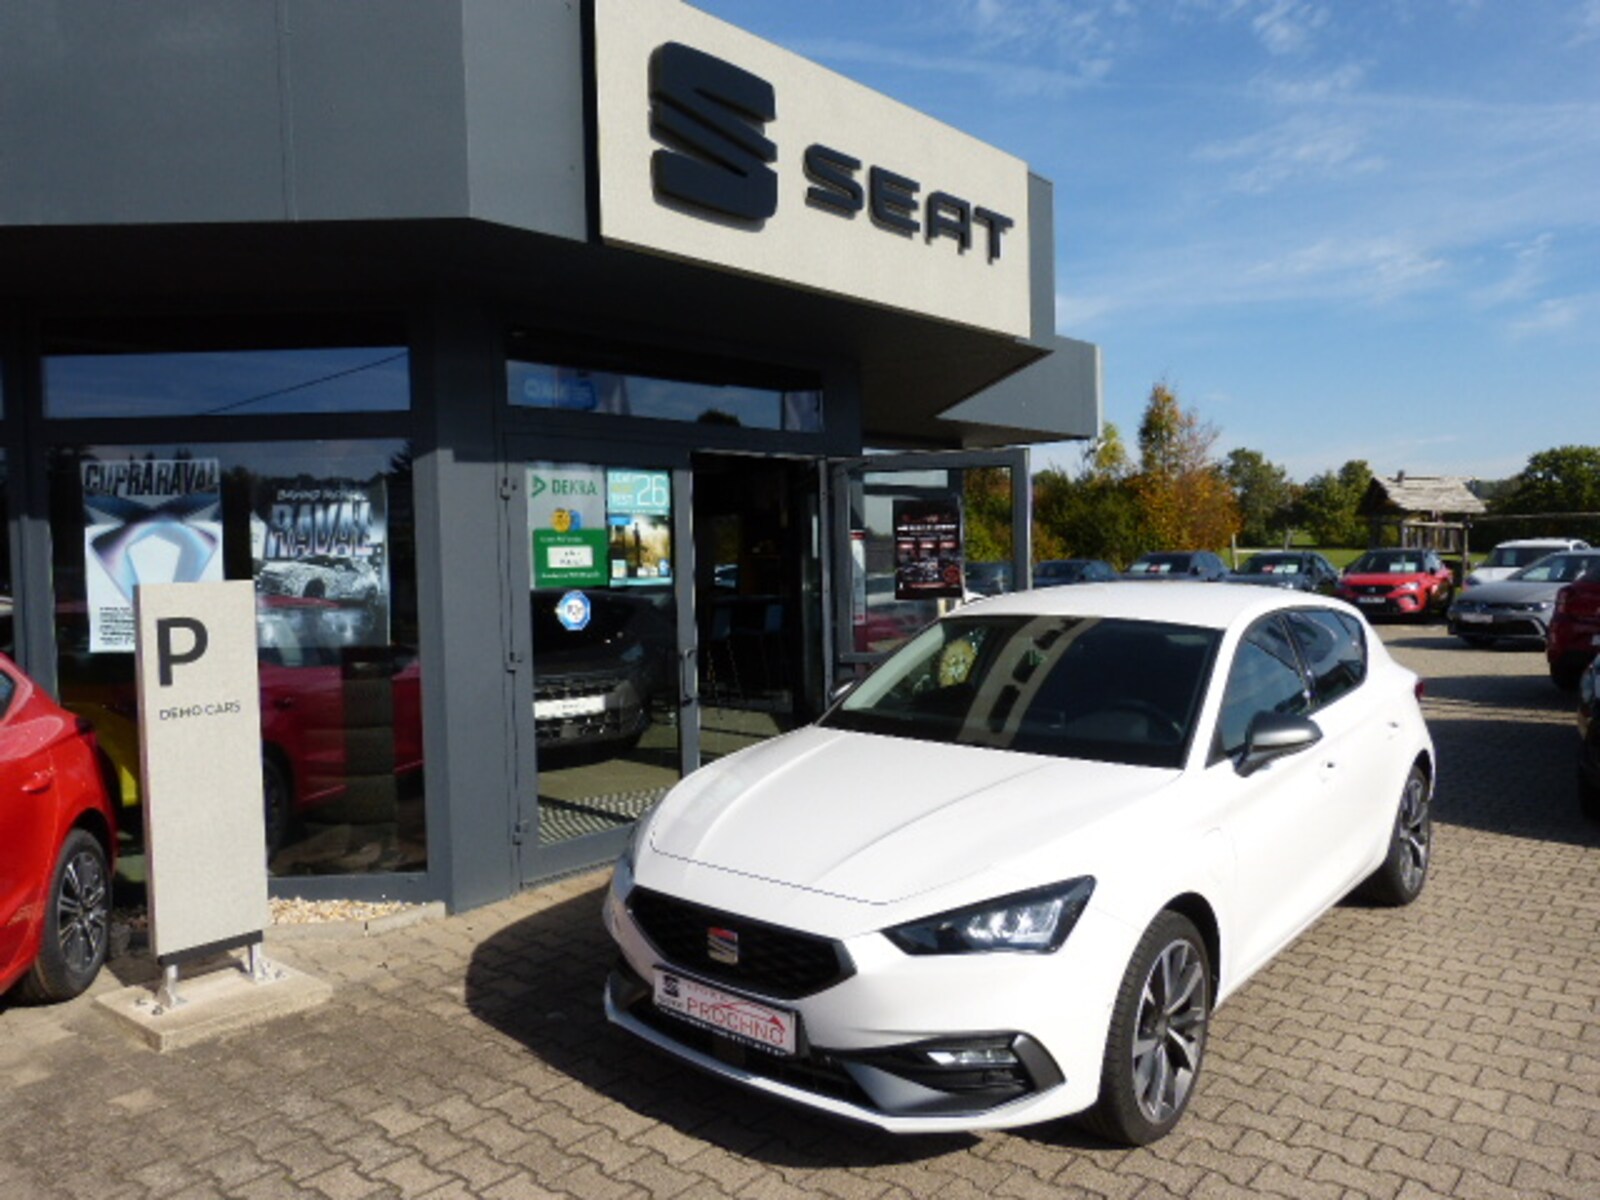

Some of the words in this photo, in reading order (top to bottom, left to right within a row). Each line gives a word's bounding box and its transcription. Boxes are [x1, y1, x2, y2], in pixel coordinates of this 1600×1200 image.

[804, 143, 1014, 265] SEAT
[551, 478, 599, 497] DEKRA
[636, 474, 668, 507] 26
[265, 501, 374, 558] RAVAL
[157, 617, 208, 688] P
[159, 705, 202, 721] DEMO
[204, 701, 242, 715] CARS
[687, 996, 785, 1046] PROCHNO
